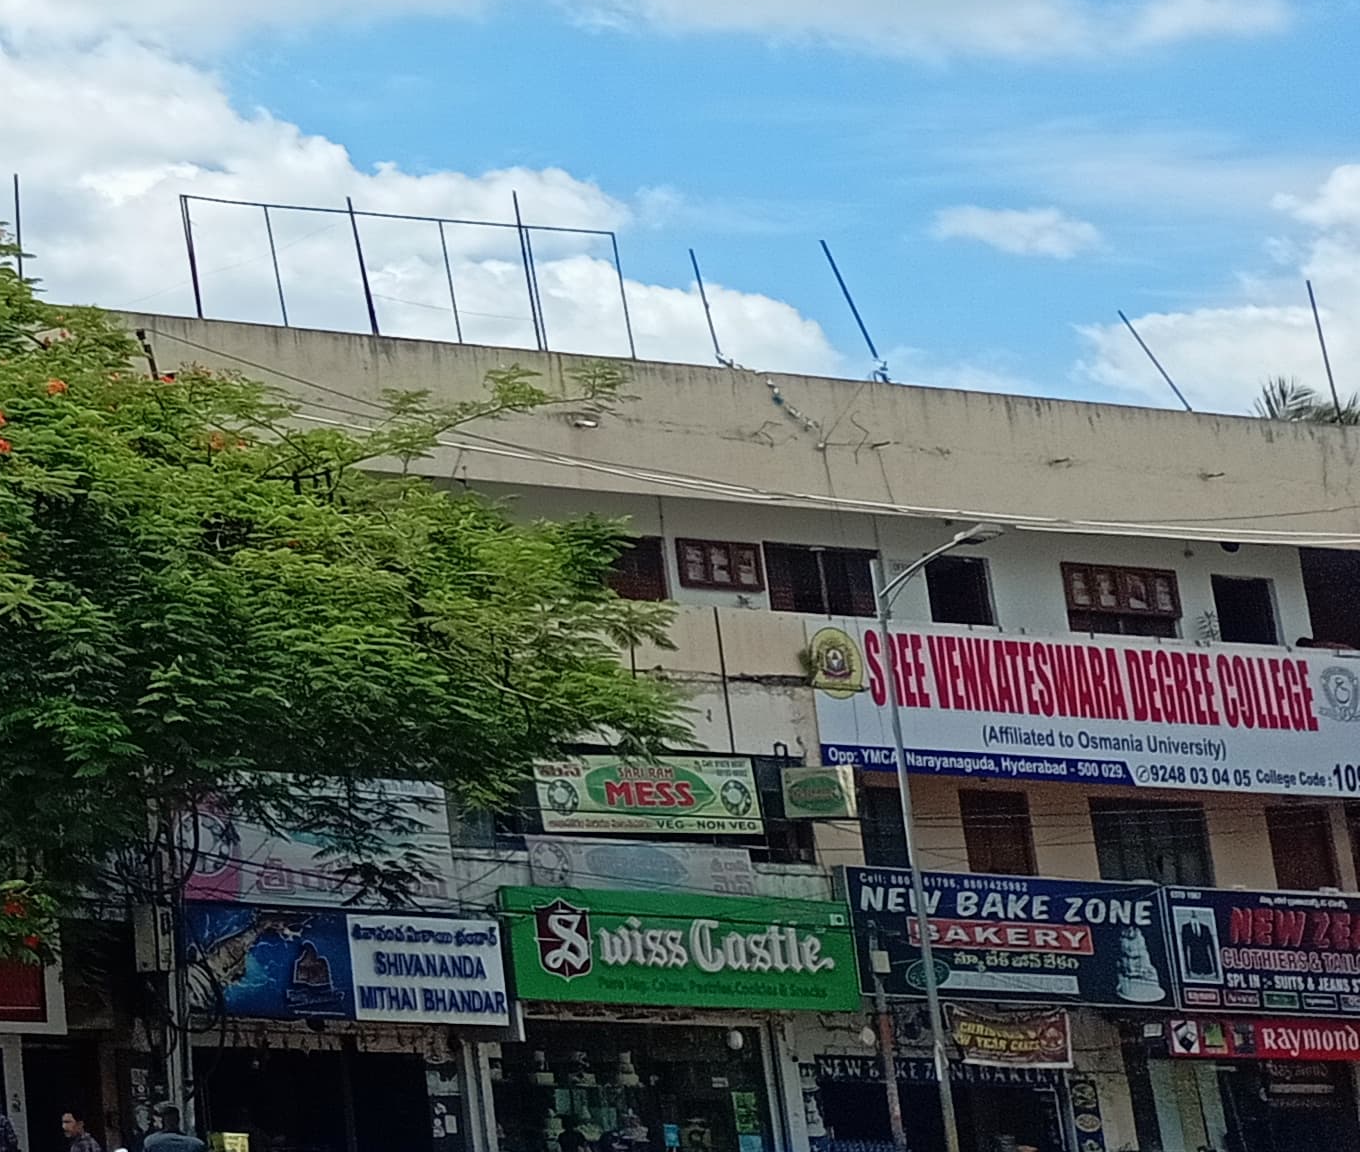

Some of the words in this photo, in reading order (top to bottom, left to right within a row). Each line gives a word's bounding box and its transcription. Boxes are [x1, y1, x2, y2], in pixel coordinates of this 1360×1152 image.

[864, 629, 931, 708] SREE
[927, 635, 1127, 722] VENKATESWARA
[1126, 649, 1219, 725] DEGREE
[1216, 654, 1319, 731] COLLEGE
[983, 723, 1055, 748] (Affiliated
[1059, 731, 1073, 747] to
[1078, 731, 1142, 752] Osmania
[1147, 735, 1227, 761] University)
[619, 767, 644, 778] SHRI
[648, 768, 673, 778] RAM
[828, 747, 859, 765] Opp:
[906, 752, 999, 773] Narayanaguda,
[1002, 757, 1066, 776] Hyderabad
[1077, 762, 1099, 777] 500
[1150, 765, 1186, 783] 9248
[1191, 768, 1208, 785] 03
[1212, 768, 1229, 786] 04
[1234, 770, 1251, 787] 05
[1256, 769, 1297, 788] College
[604, 781, 695, 807] MESS
[657, 820, 684, 829] VEG
[697, 821, 726, 830] NON
[730, 821, 757, 830] VEG
[860, 886, 941, 915] NEW
[956, 891, 1050, 919] BAKE
[1064, 897, 1153, 925] ZONE
[915, 924, 1086, 948] BAKERY
[1232, 907, 1306, 947] NEW
[374, 951, 487, 979] SHIVANANDA
[1221, 947, 1307, 972] CLOTHIERS
[1227, 973, 1247, 987] SPL
[1249, 974, 1260, 989] IN
[1274, 975, 1305, 990] SUITS
[1318, 979, 1350, 993] JEANS
[359, 985, 418, 1010] MITHAI
[423, 988, 506, 1014] BHANDAR
[1262, 1025, 1360, 1057] Raymond
